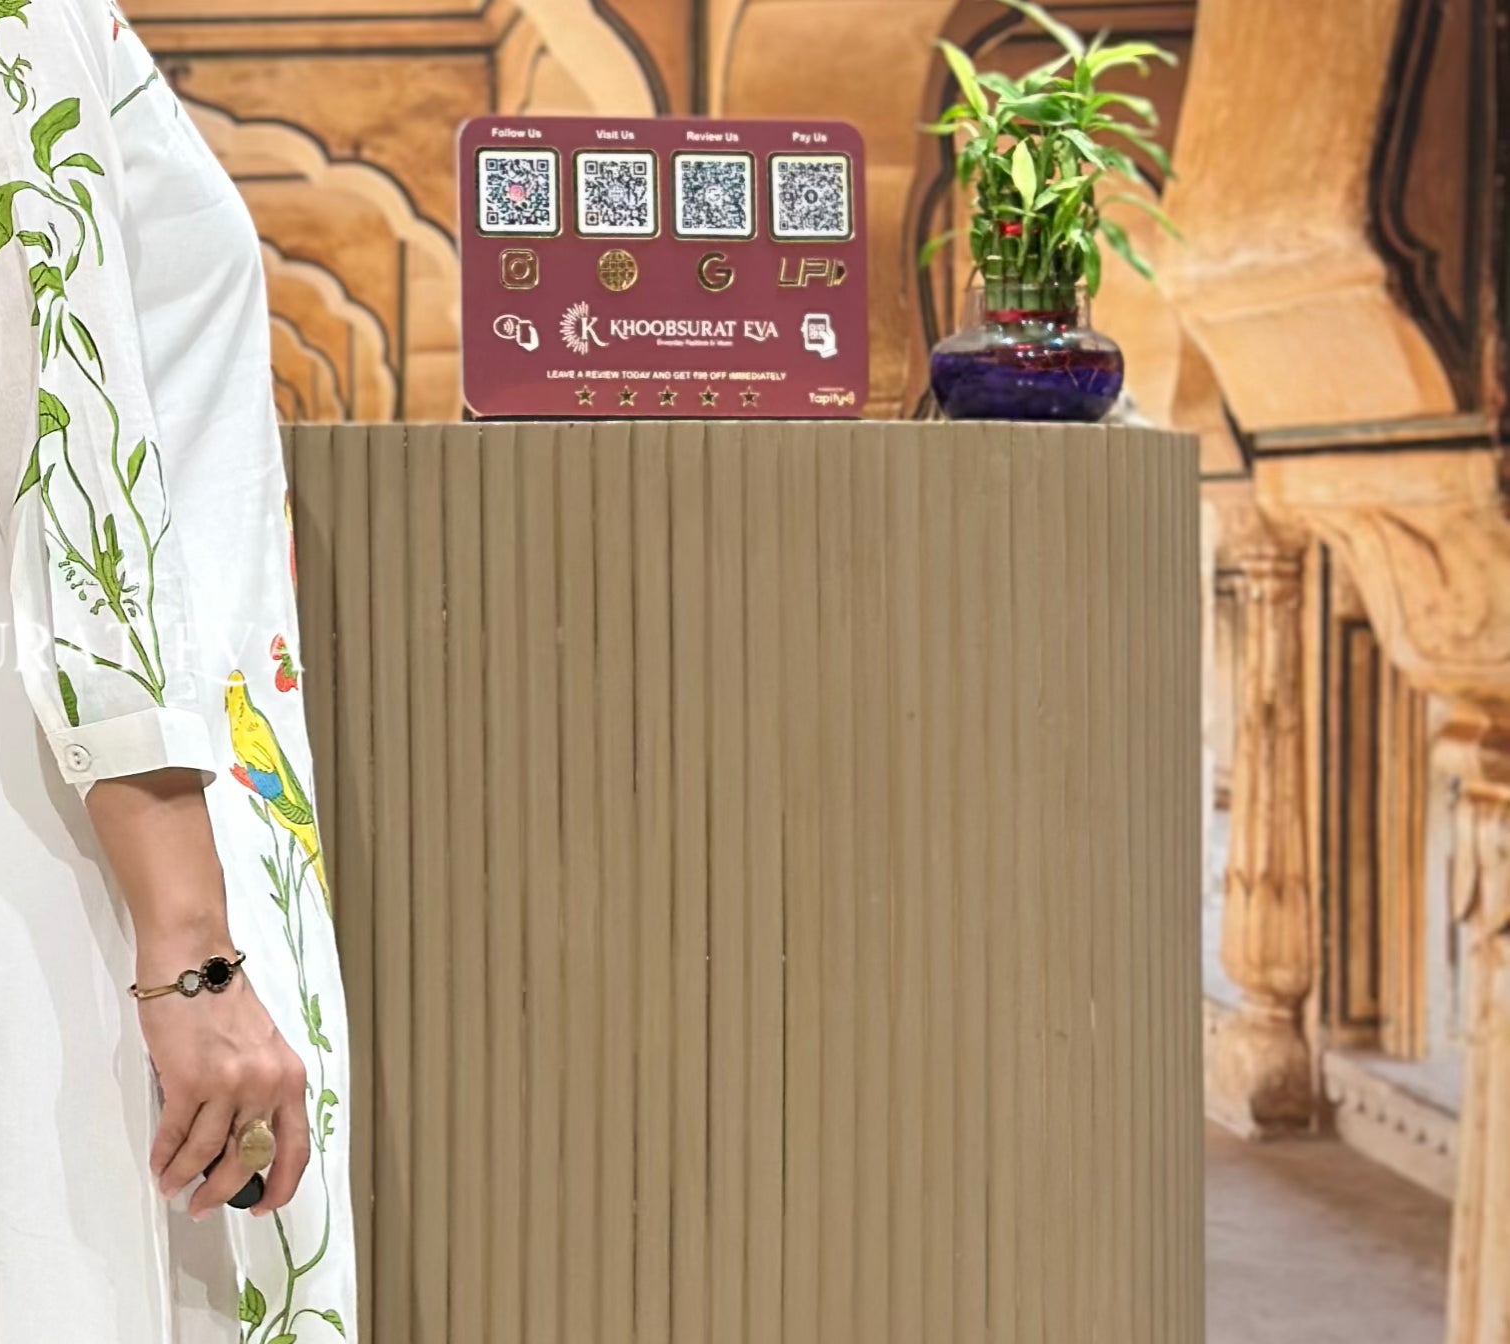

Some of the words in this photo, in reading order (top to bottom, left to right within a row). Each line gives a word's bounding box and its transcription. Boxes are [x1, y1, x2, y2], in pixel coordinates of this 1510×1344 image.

[491, 127, 525, 138] Follow
[527, 129, 542, 139] Us
[595, 129, 619, 140] Visit
[621, 131, 635, 140] Us
[686, 131, 723, 142] Review
[725, 132, 739, 142] Us
[792, 131, 811, 144] Pay
[813, 133, 828, 143] Us
[610, 319, 737, 340] KHOOBSURAT
[743, 320, 779, 342] EVA
[546, 370, 575, 379] LEAVE
[577, 370, 584, 378] A
[585, 370, 620, 379] REVIEW
[621, 370, 650, 379] TODAY
[652, 371, 671, 380] AND
[673, 371, 691, 380] GET
[709, 371, 728, 381] OFF
[729, 371, 787, 381] IMMEDIATELY
